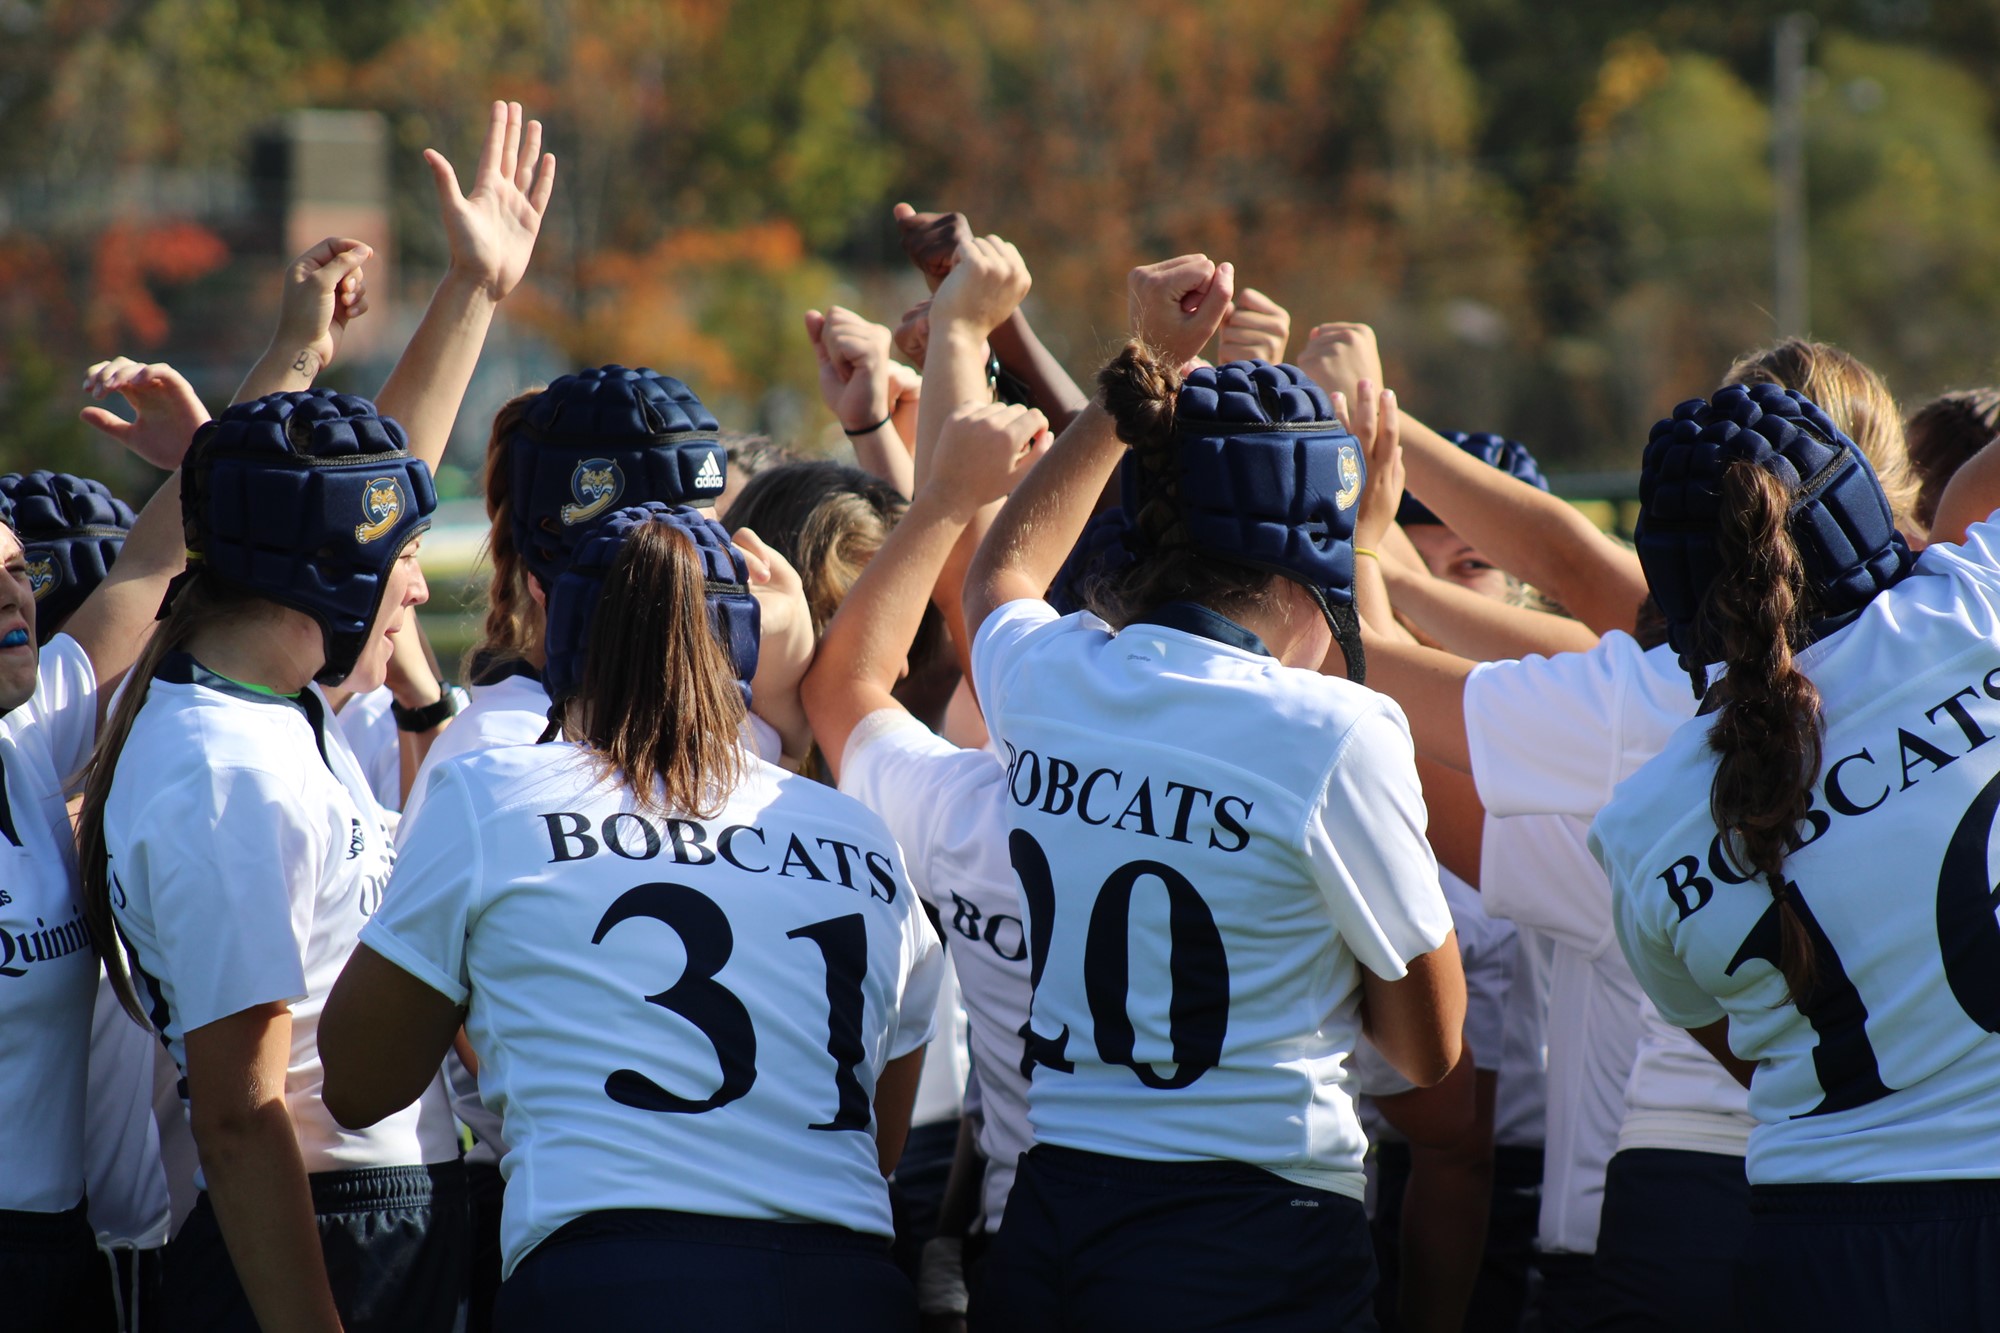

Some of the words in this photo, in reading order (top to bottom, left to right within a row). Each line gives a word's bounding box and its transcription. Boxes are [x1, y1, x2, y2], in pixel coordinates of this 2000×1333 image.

[695, 474, 723, 488] adidas
[538, 812, 898, 904] BOBCATS
[591, 882, 871, 1131] 31
